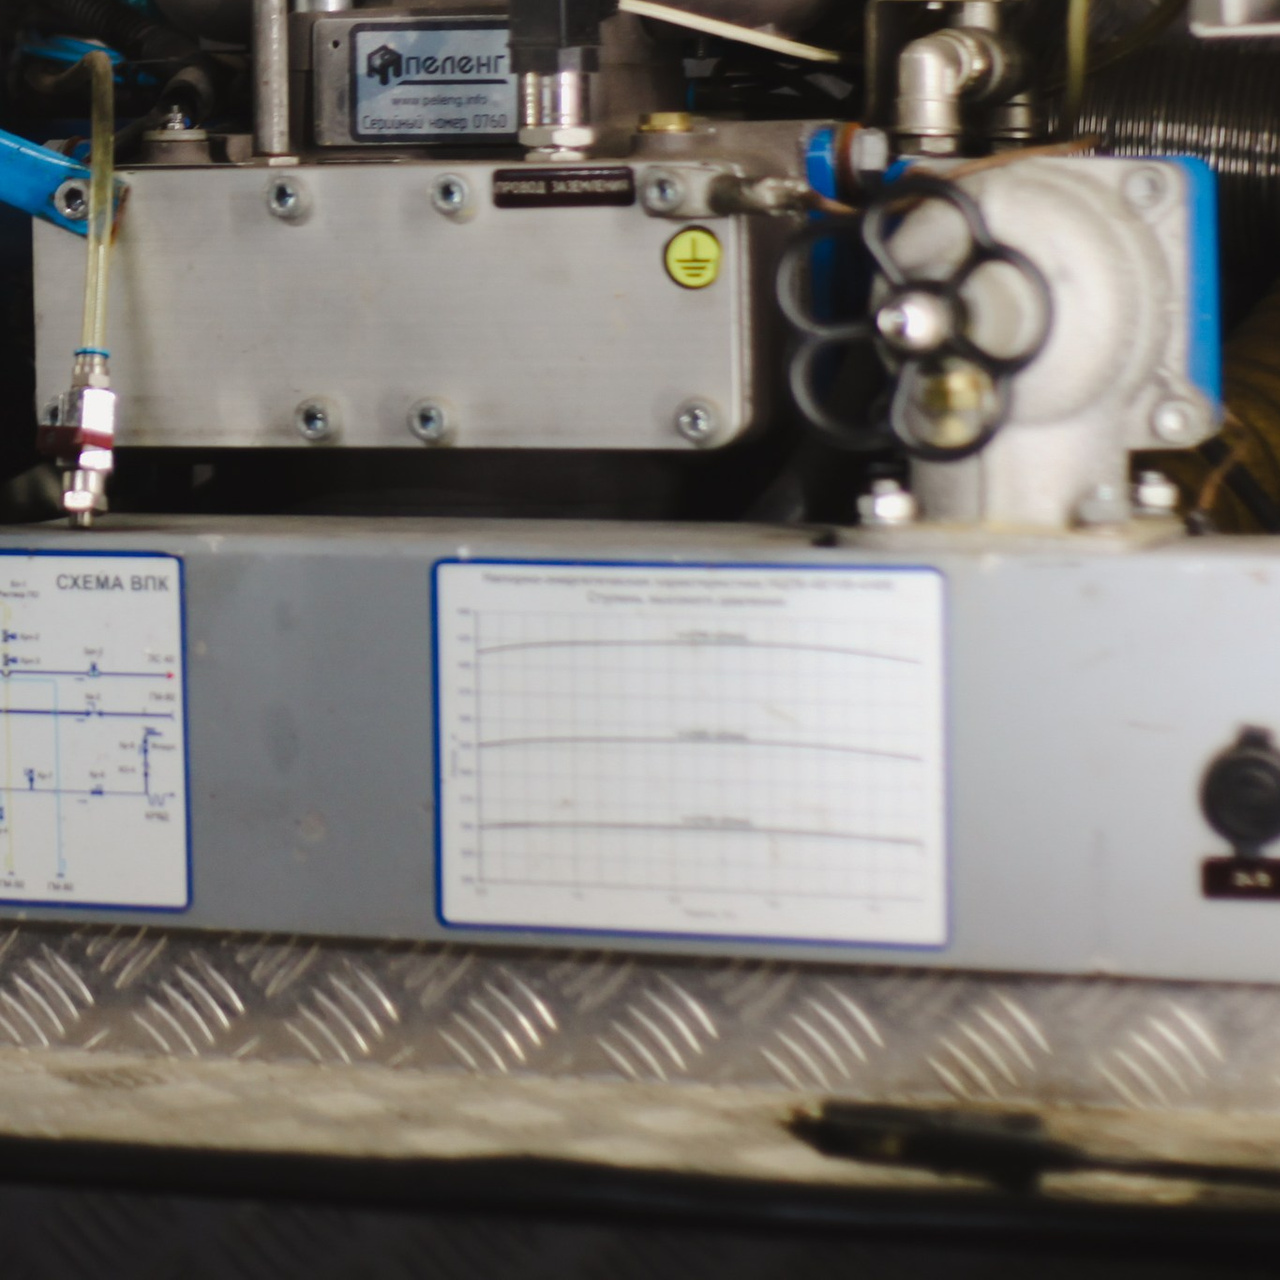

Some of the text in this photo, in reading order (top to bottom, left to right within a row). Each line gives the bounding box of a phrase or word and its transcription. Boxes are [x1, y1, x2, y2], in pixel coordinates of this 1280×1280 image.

[362, 114, 423, 132] Серийный
[56, 574, 170, 592] СХЕМА ВПК
